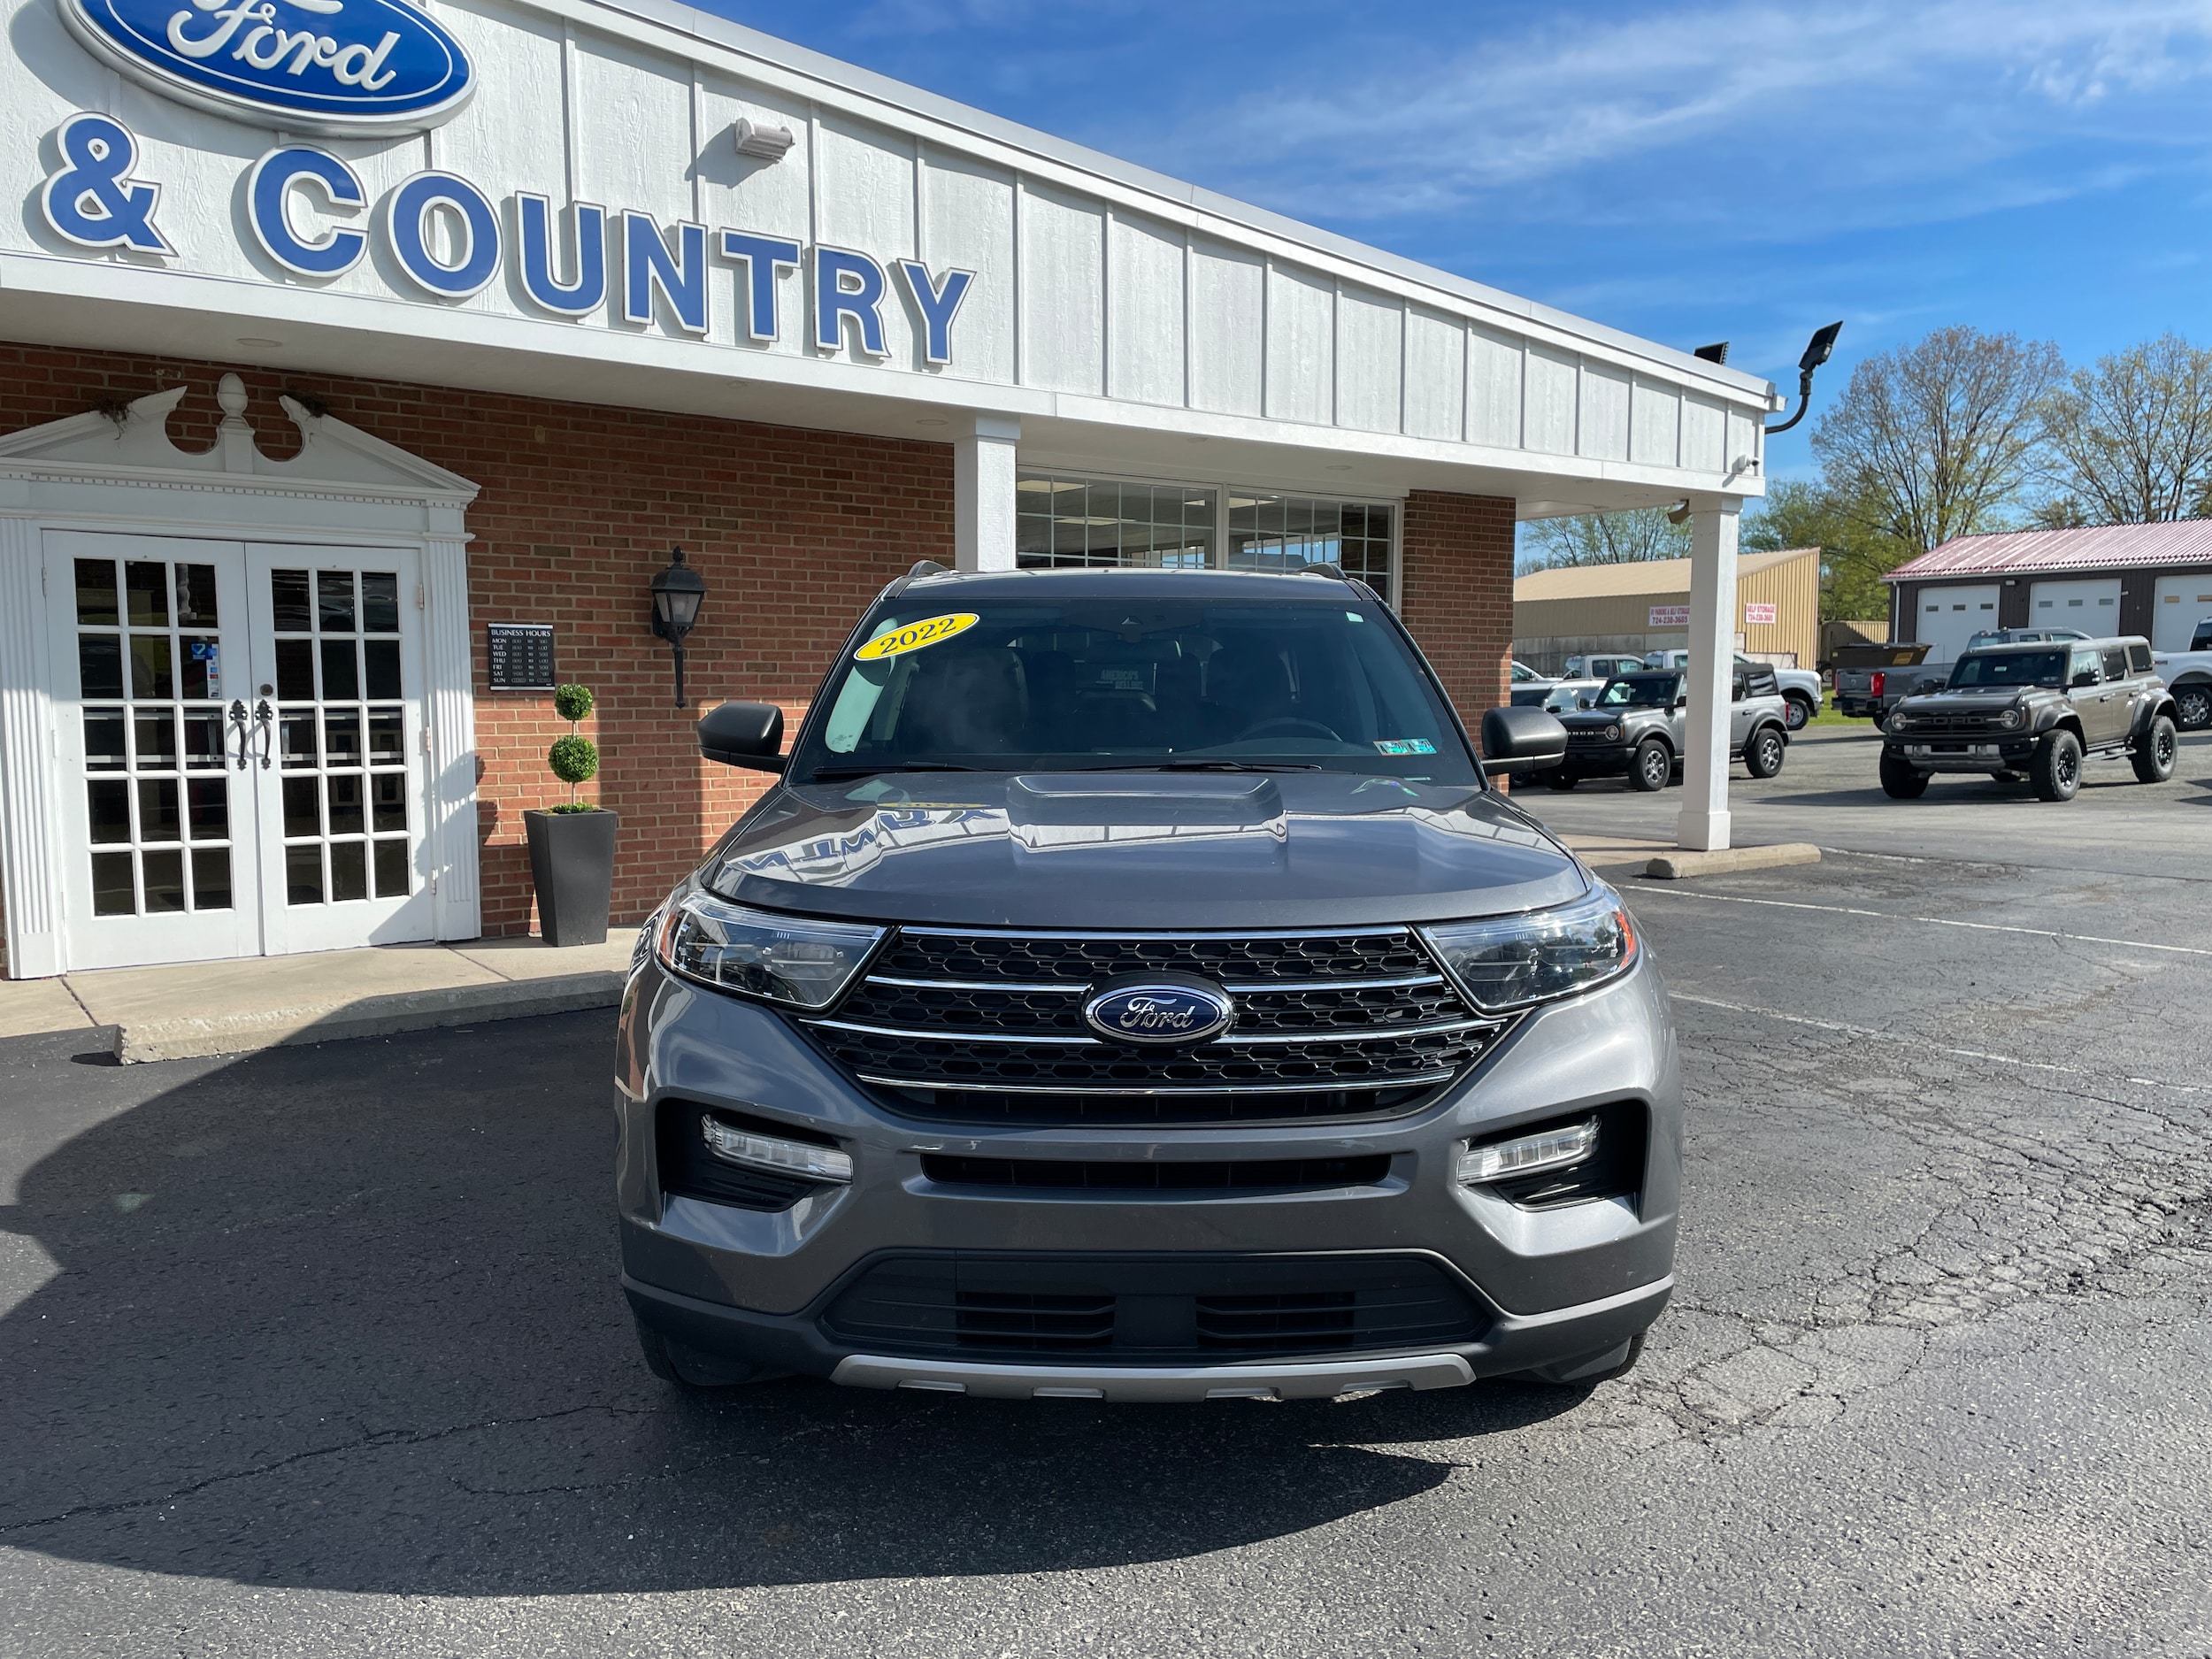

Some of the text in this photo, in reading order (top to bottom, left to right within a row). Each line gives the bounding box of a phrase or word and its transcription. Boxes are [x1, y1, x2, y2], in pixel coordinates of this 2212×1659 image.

[166, 0, 401, 91] Ford
[42, 111, 977, 366] & COUNTRY
[879, 618, 957, 655] 2022
[1119, 996, 1196, 1028] Ford
